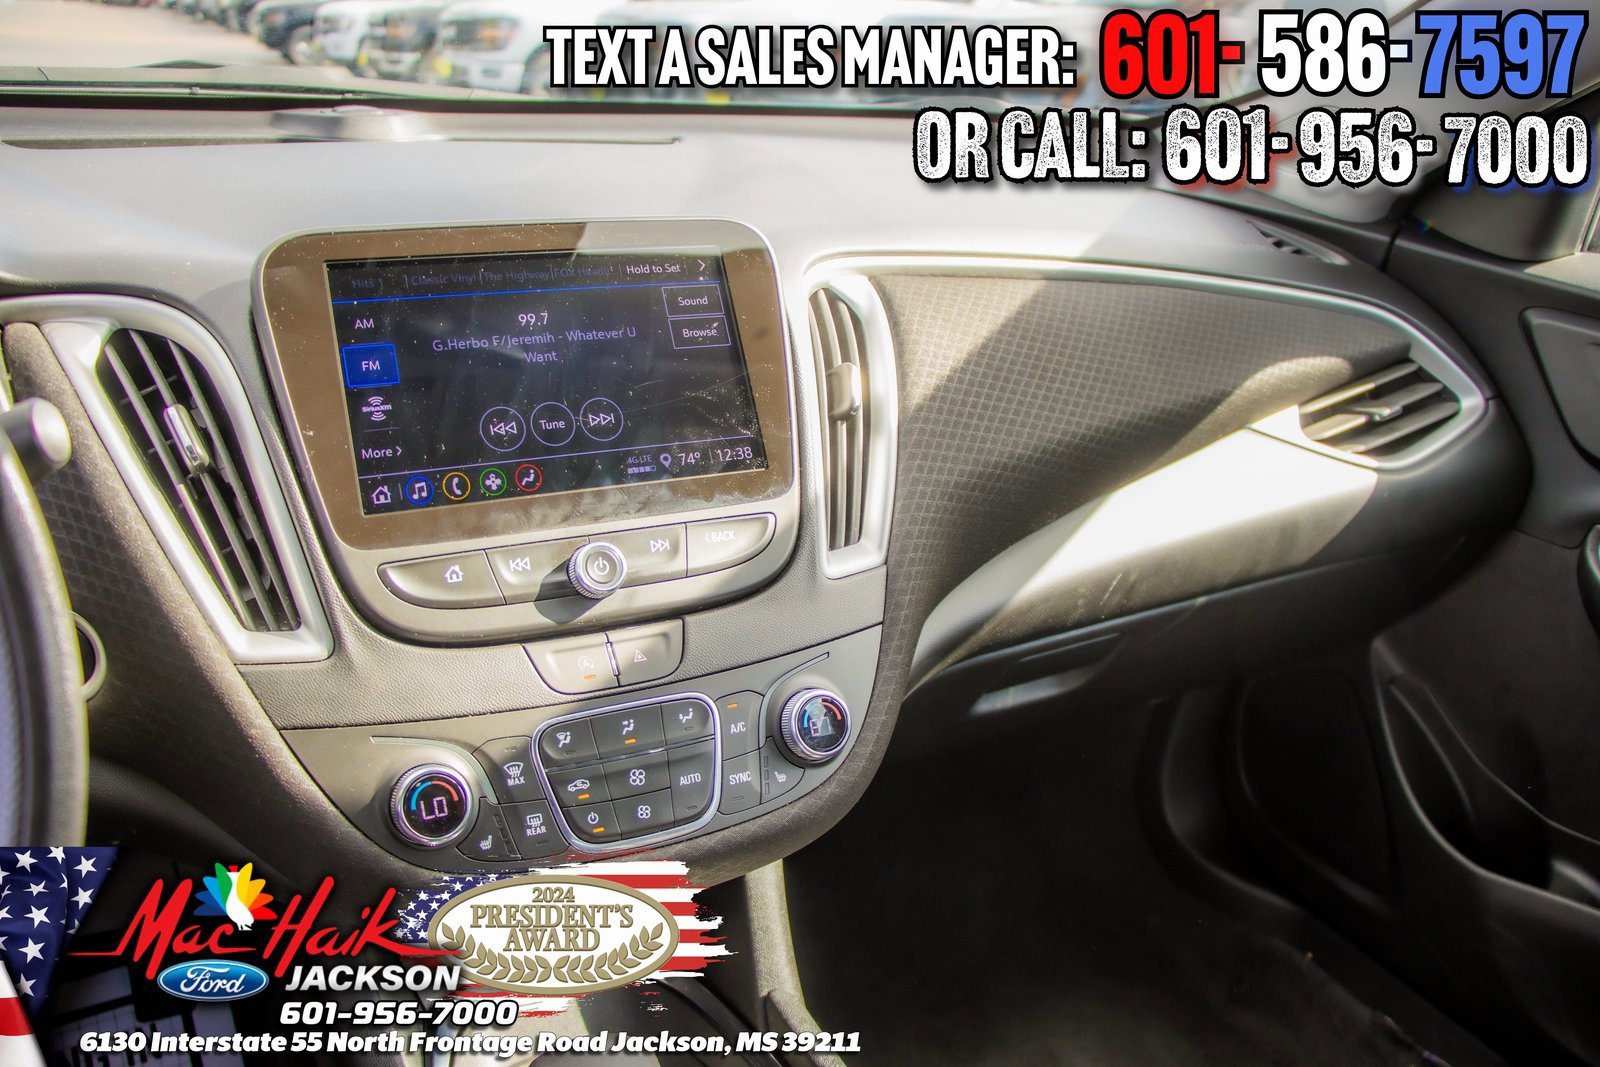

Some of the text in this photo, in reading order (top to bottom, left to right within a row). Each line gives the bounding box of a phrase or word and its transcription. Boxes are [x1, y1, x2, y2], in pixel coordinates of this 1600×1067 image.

[506, 269, 550, 281] Highway
[626, 263, 681, 275] Hold to Set
[411, 275, 449, 286] Classic
[678, 295, 709, 306] Sound
[354, 318, 375, 330] AM
[518, 311, 548, 326] 99.7
[432, 335, 489, 352] G.Herbo
[565, 328, 624, 342] Whatever
[627, 326, 637, 338] U
[682, 327, 718, 339] Browse
[524, 350, 558, 363] Want
[361, 360, 381, 371] FM
[539, 419, 565, 431] Tune
[361, 448, 393, 460] More
[716, 446, 753, 462] 12:38
[710, 529, 736, 543] BACK
[730, 722, 746, 735] A/C
[507, 776, 526, 787] MAX
[679, 772, 702, 786] AUTO
[729, 771, 752, 785] SYNC
[526, 825, 547, 837] REAR
